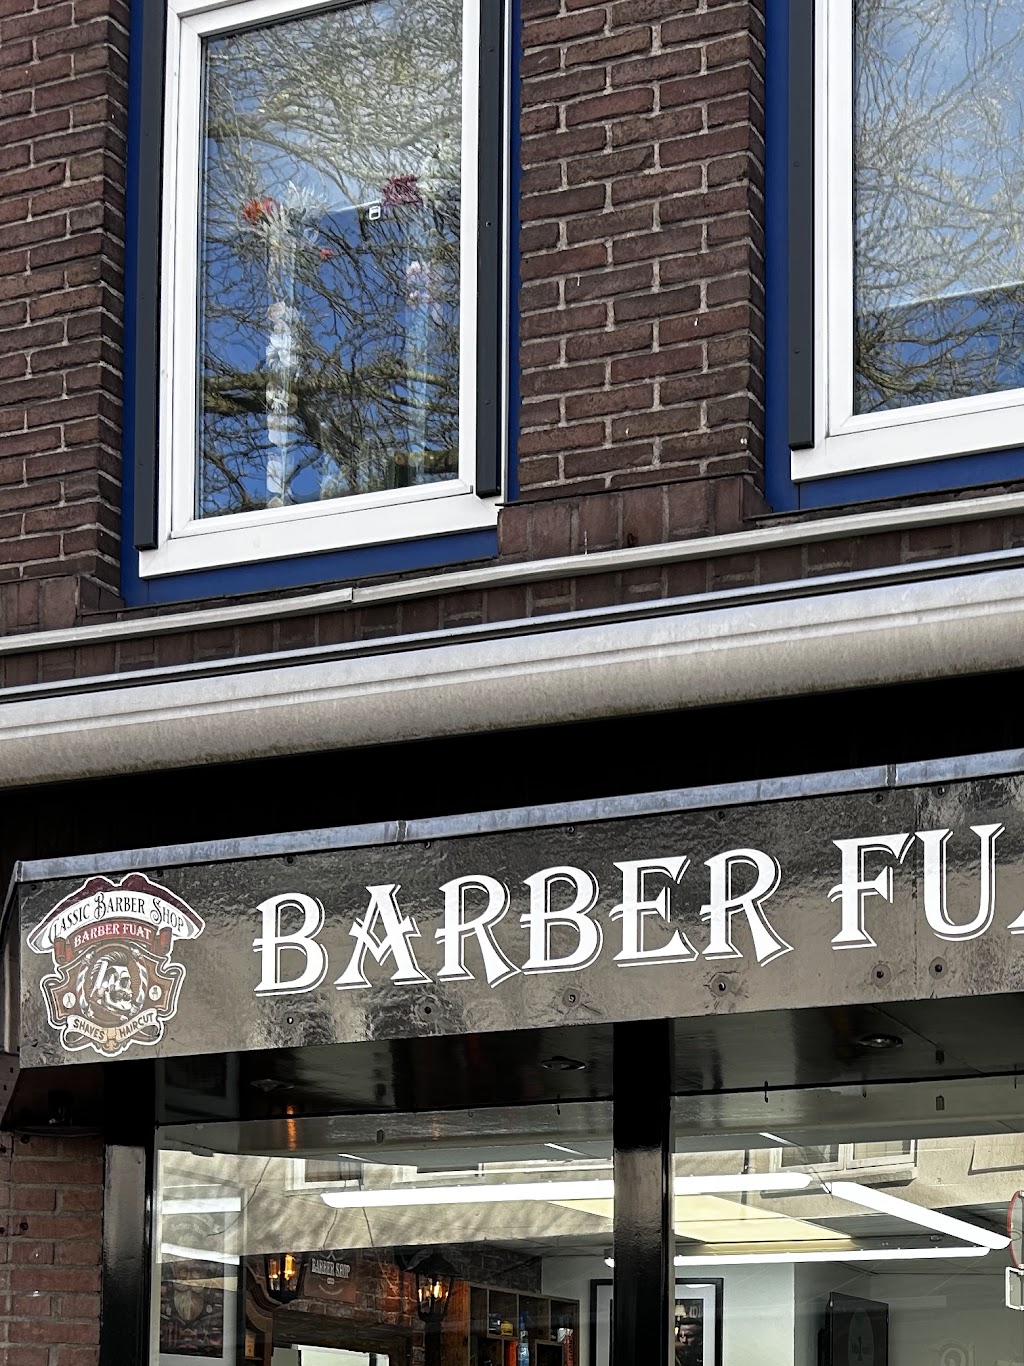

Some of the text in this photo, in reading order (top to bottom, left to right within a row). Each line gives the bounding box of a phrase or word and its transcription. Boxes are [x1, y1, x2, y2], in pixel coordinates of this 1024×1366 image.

[49, 892, 185, 940] CLASSIC BARBER SHOP
[253, 848, 794, 996] BARBER
[73, 923, 152, 948] BARBER FUAT
[73, 1012, 155, 1040] SHAVES HAIRCUT
